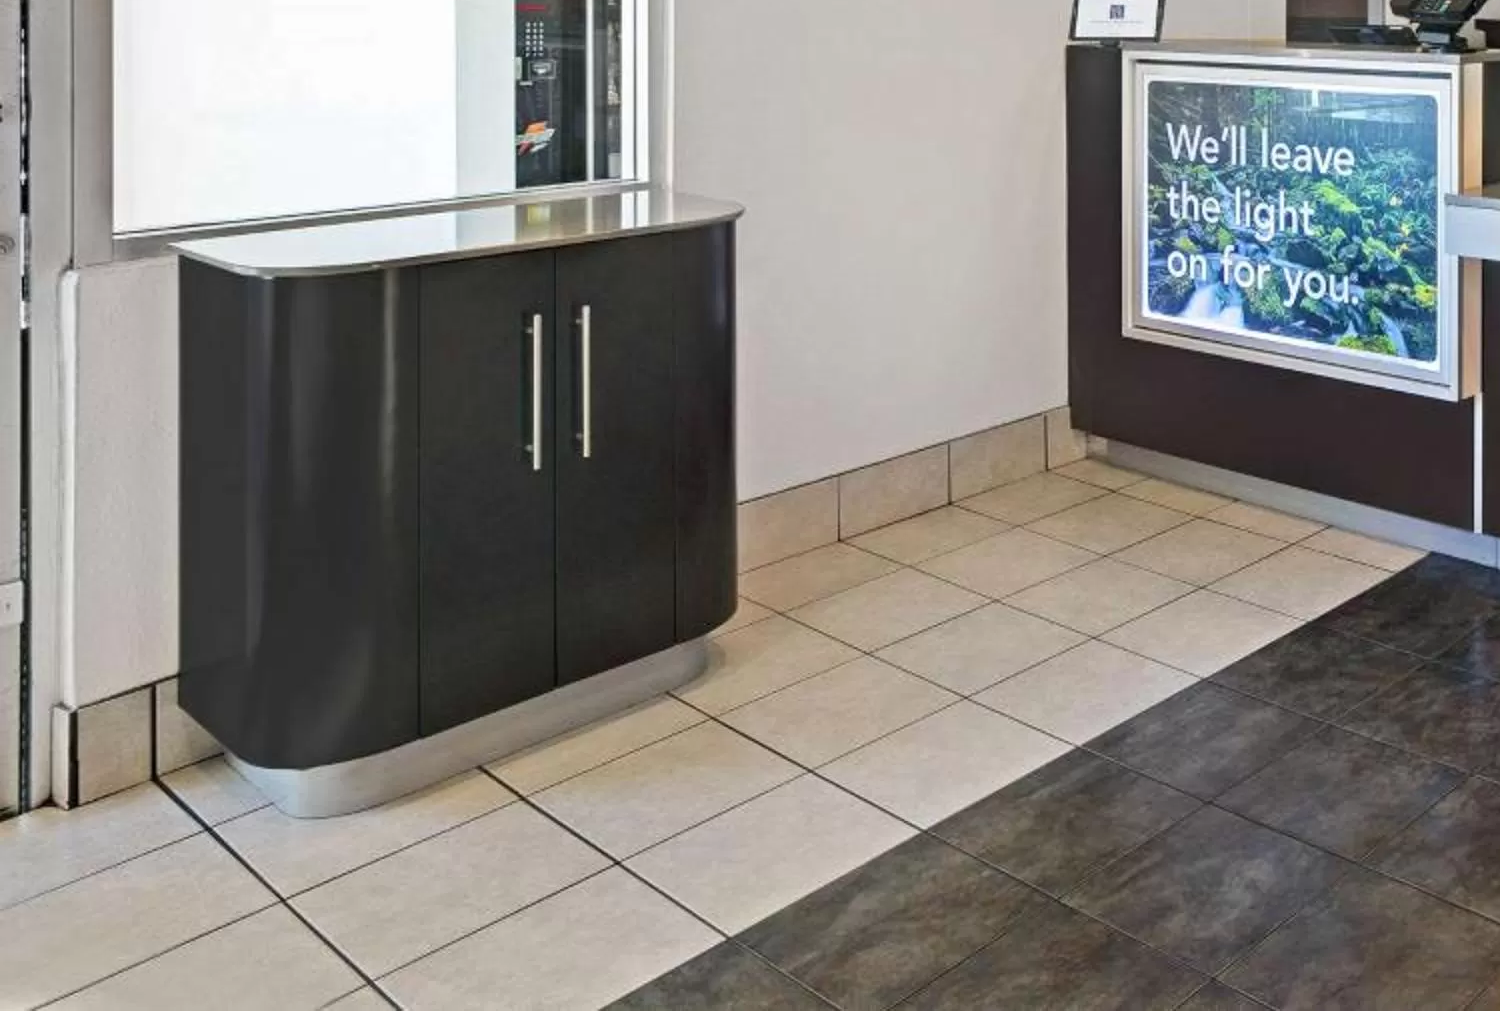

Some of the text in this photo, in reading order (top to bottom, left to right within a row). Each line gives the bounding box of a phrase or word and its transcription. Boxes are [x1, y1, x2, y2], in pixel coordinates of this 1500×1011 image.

[1166, 122, 1355, 176] We'll leave
[1167, 181, 1315, 241] the light
[1167, 245, 1359, 307] on for you.
